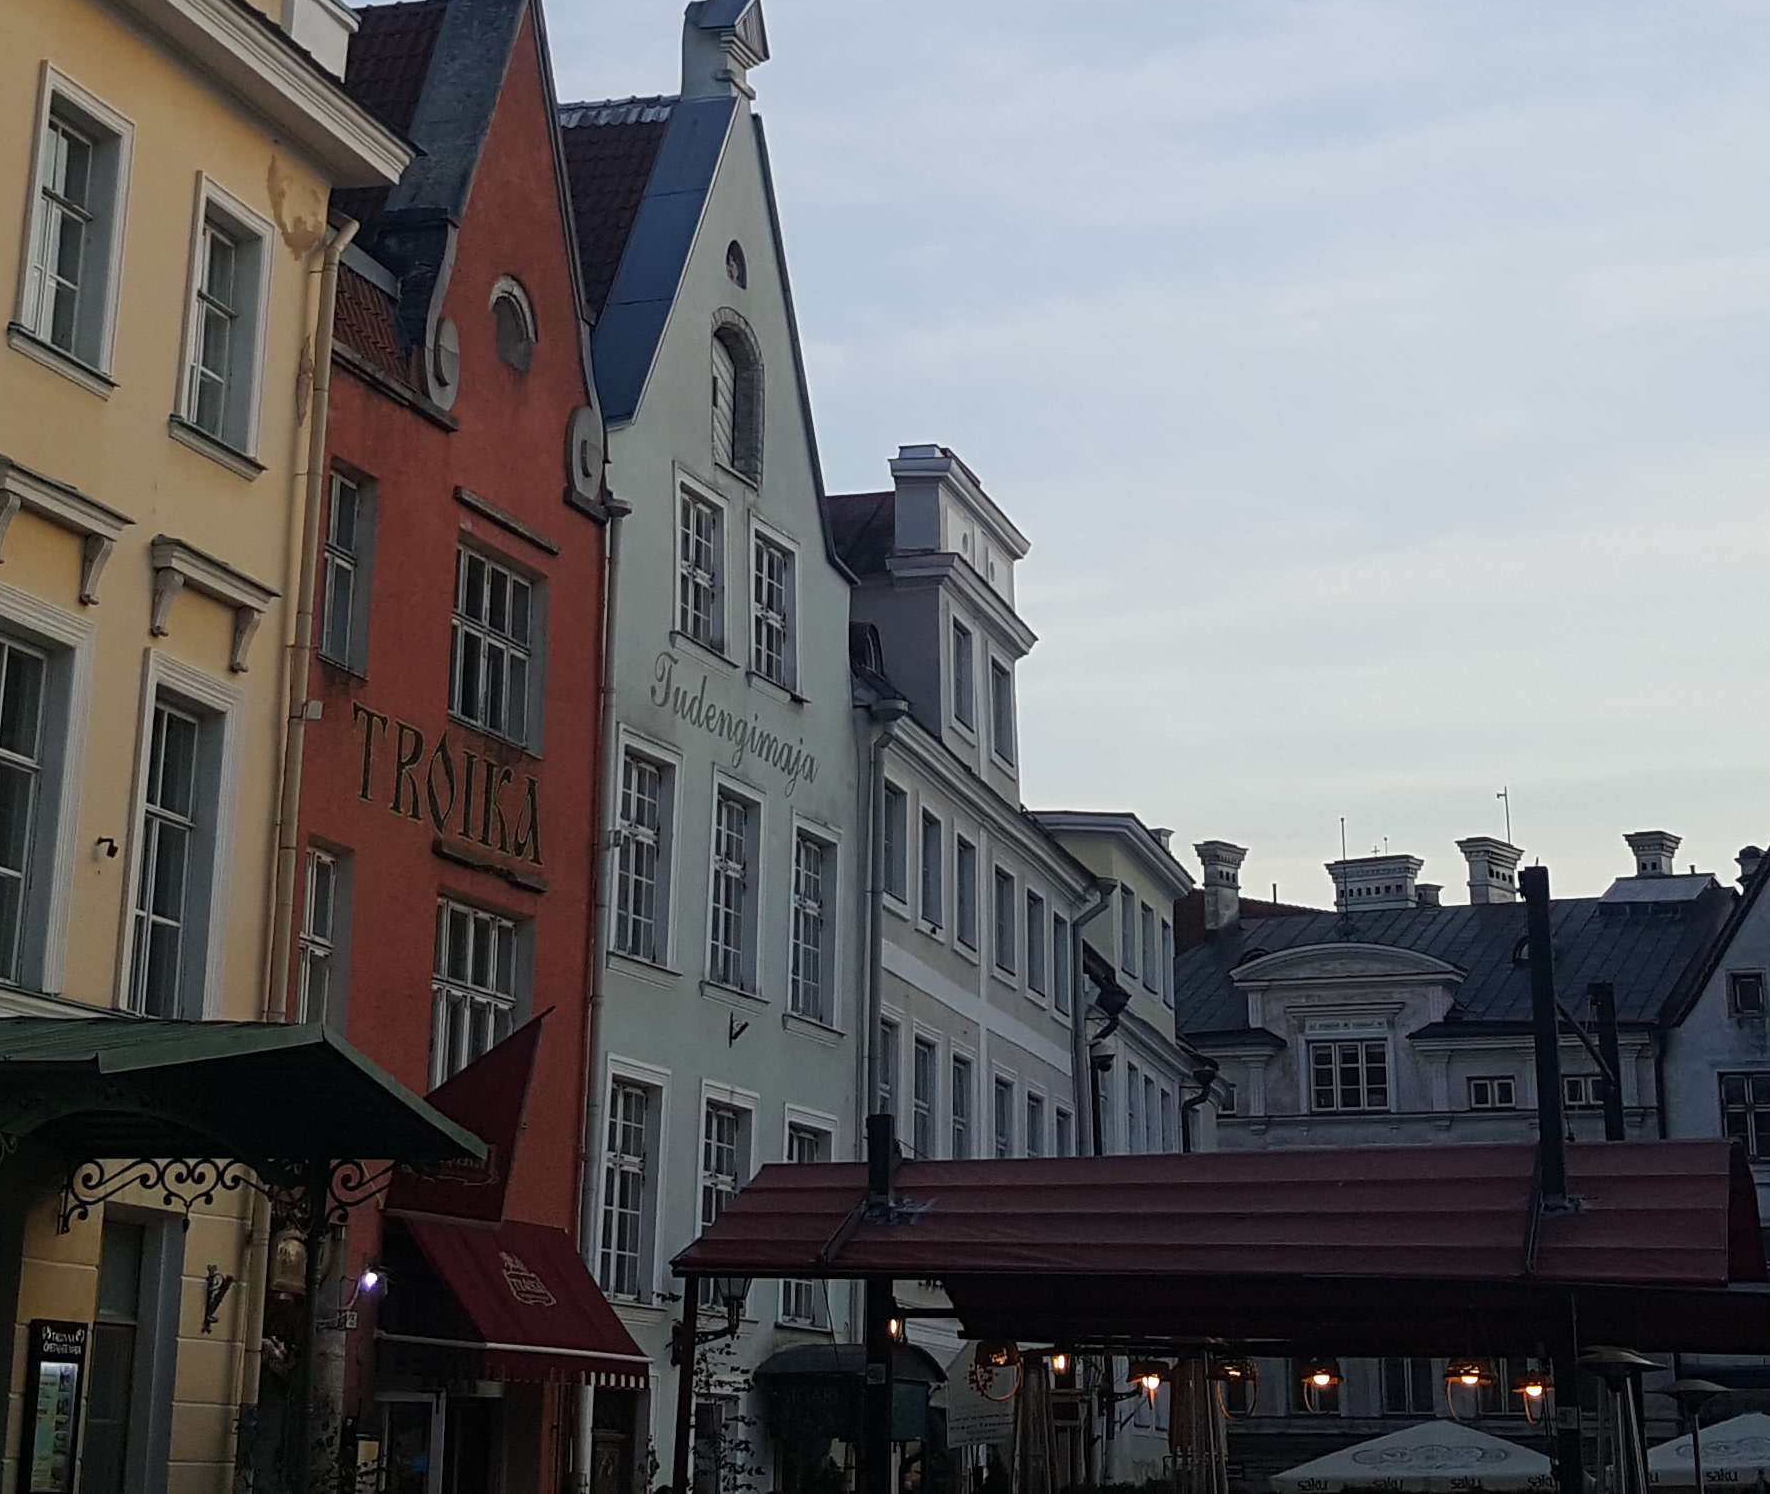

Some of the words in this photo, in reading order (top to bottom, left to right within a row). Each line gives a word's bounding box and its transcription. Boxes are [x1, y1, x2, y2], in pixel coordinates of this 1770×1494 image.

[352, 699, 544, 867] TROIKA
[650, 651, 820, 798] Tudengimaja
[1706, 1468, 1738, 1483] saku
